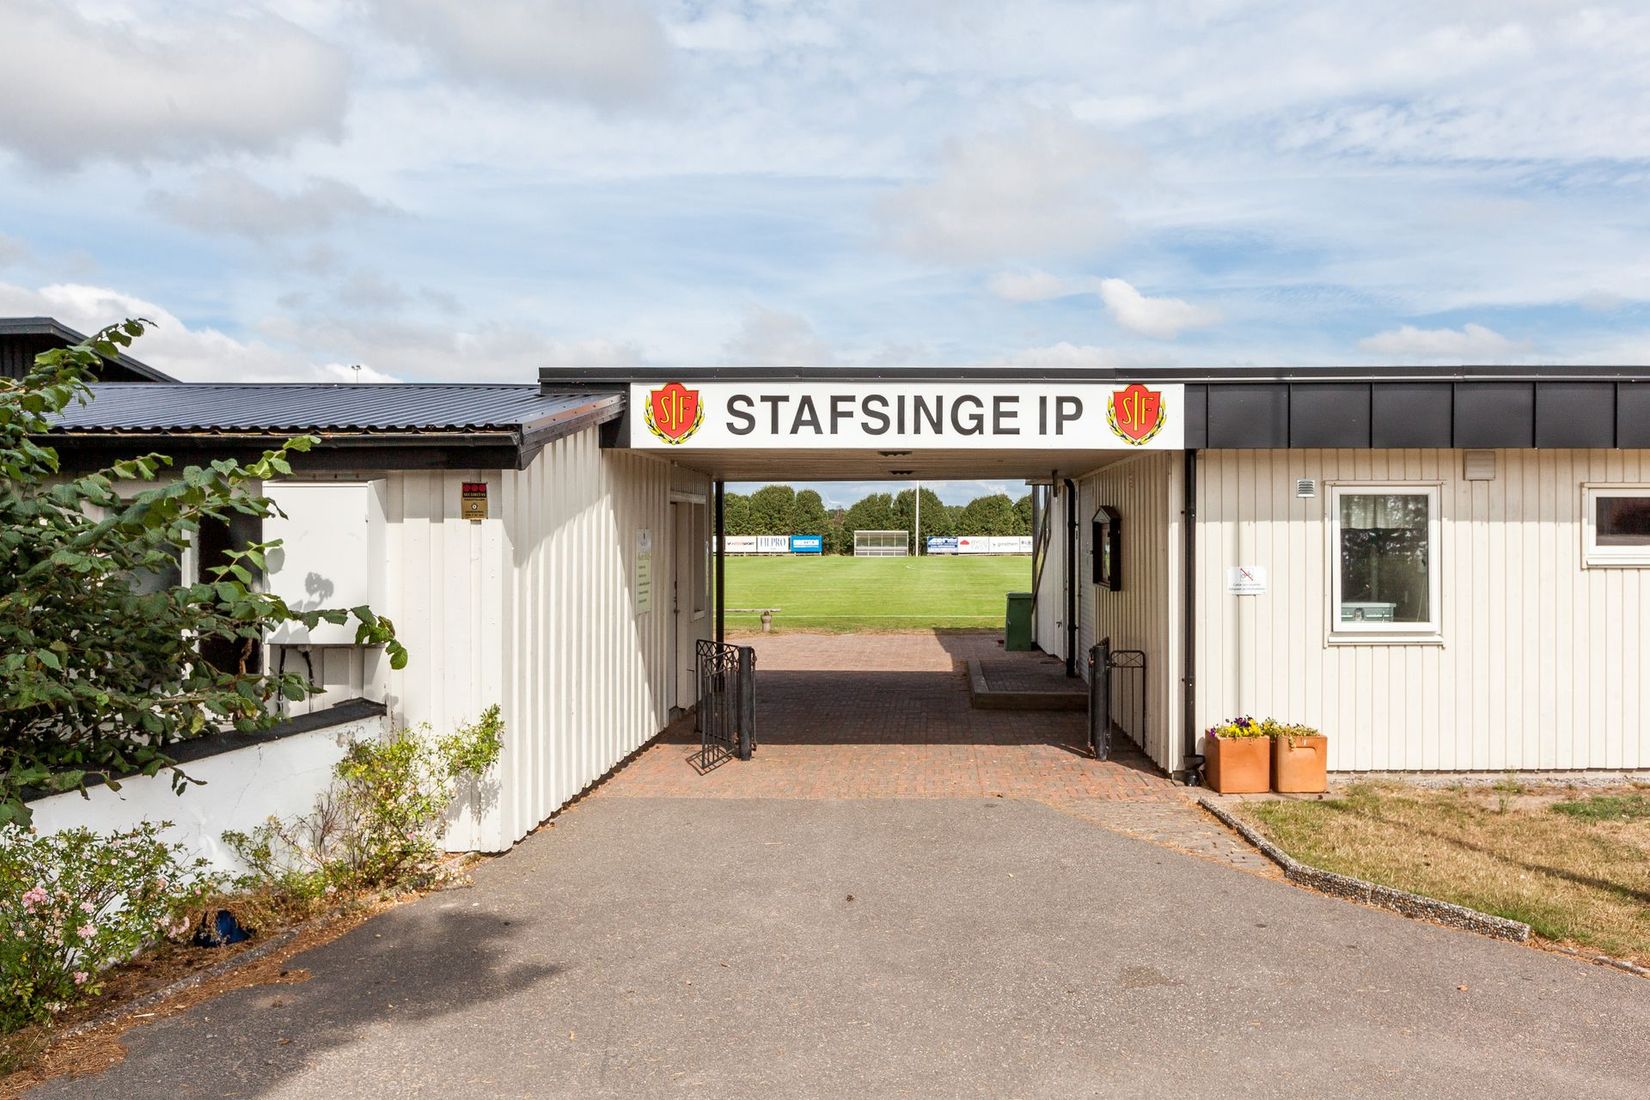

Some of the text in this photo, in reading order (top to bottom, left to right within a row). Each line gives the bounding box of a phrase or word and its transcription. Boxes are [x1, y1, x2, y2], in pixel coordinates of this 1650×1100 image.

[659, 390, 693, 431] SIF
[725, 394, 1083, 435] STAFSINGE IP
[1121, 391, 1154, 432] SIF
